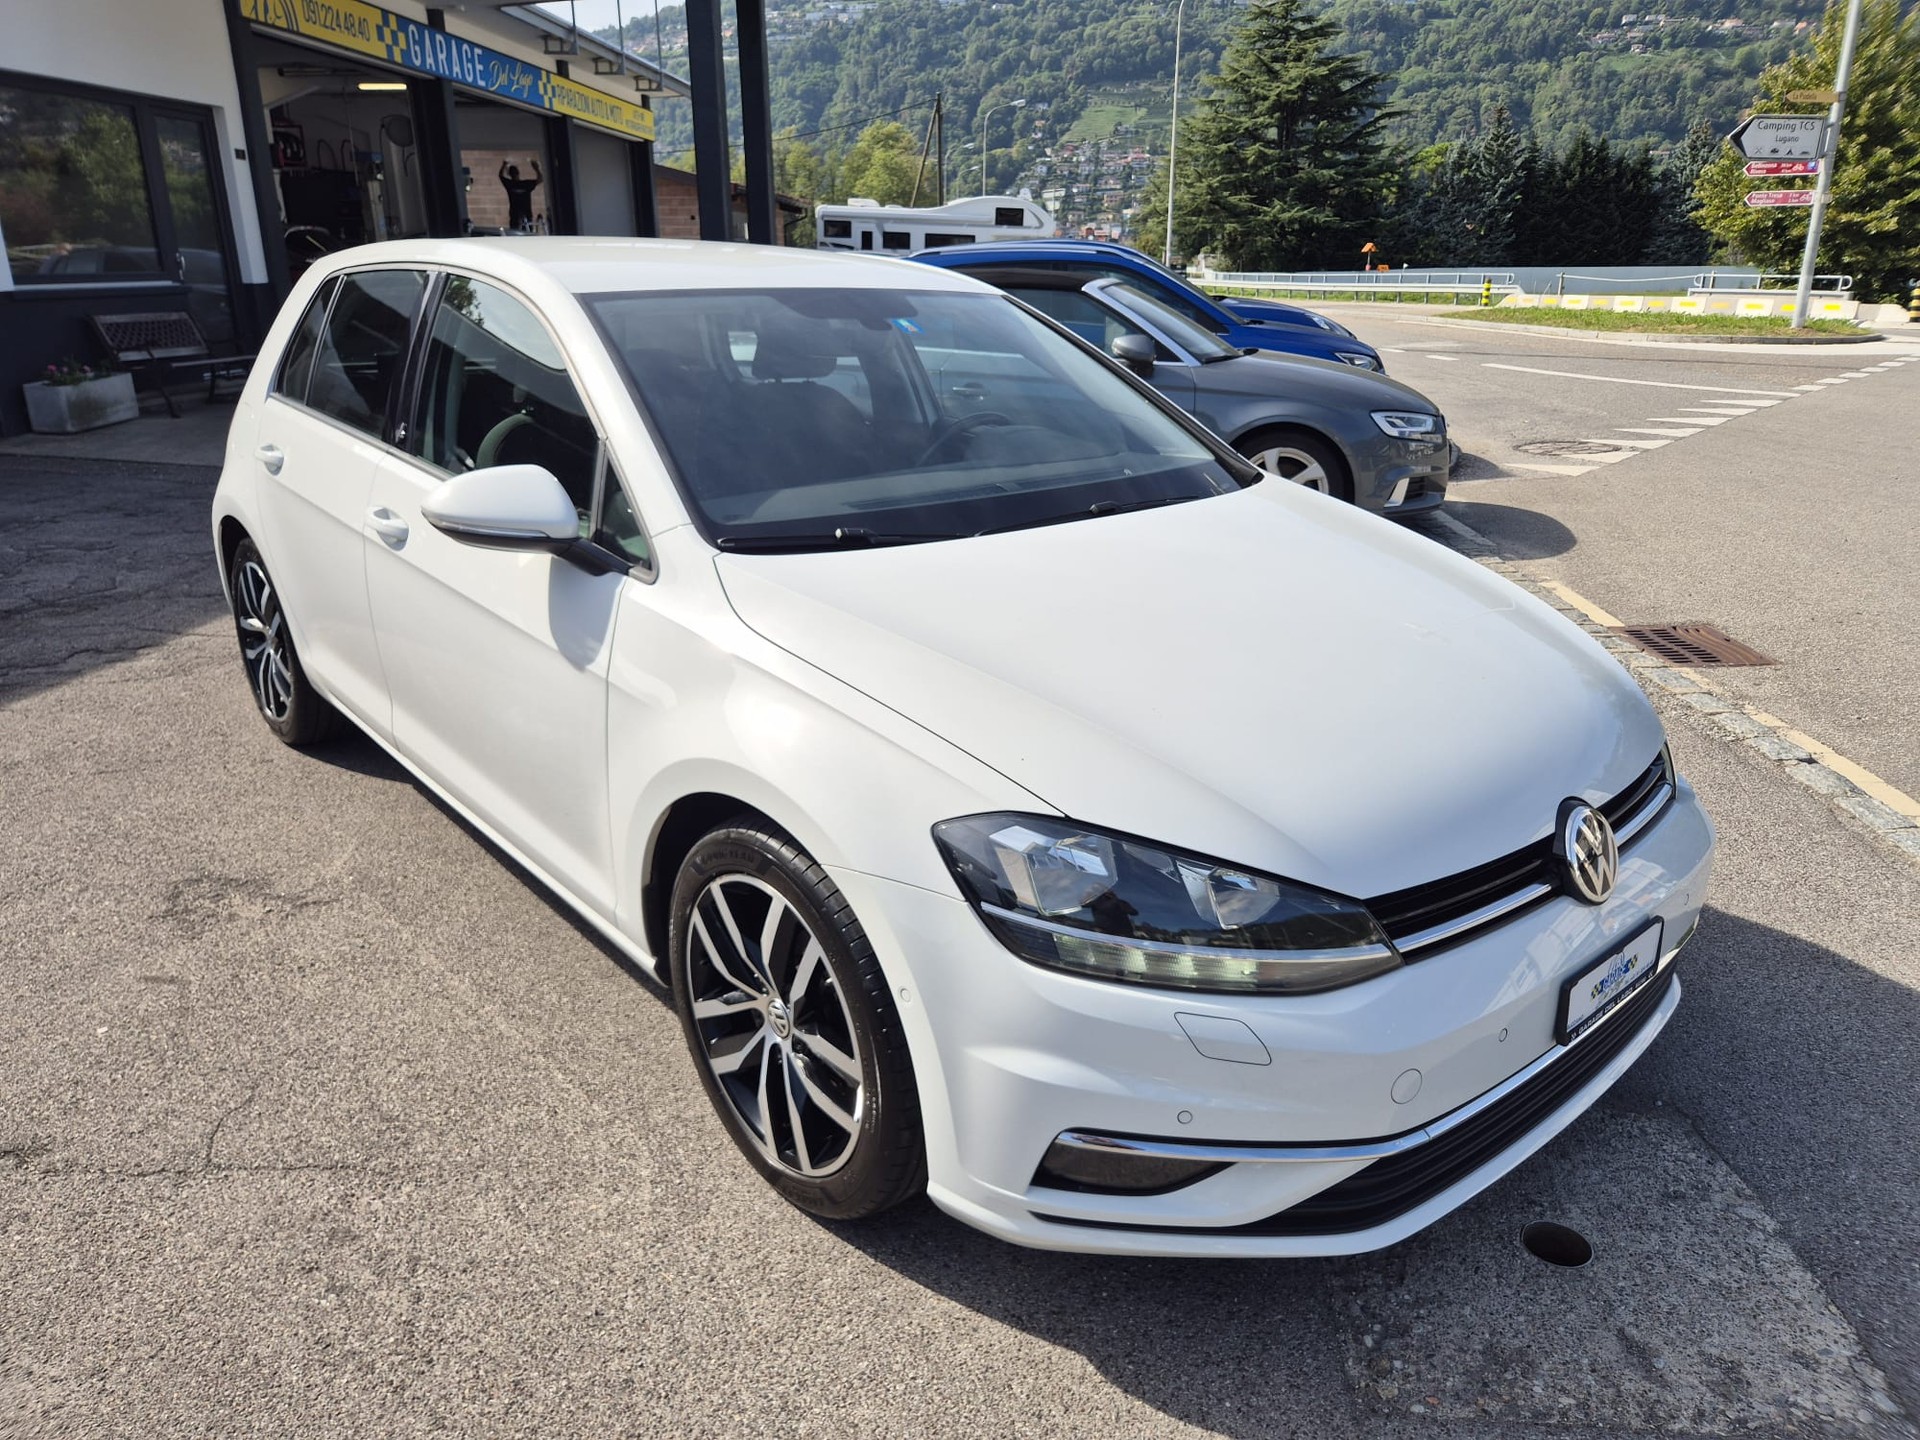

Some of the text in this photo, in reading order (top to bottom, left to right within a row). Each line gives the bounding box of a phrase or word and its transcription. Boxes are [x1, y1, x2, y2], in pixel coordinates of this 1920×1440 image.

[408, 23, 487, 87] GARAGE
[488, 60, 534, 99] Del Lago
[1757, 120, 1816, 134] Camping TCS
[1775, 135, 1800, 144] Lugano
